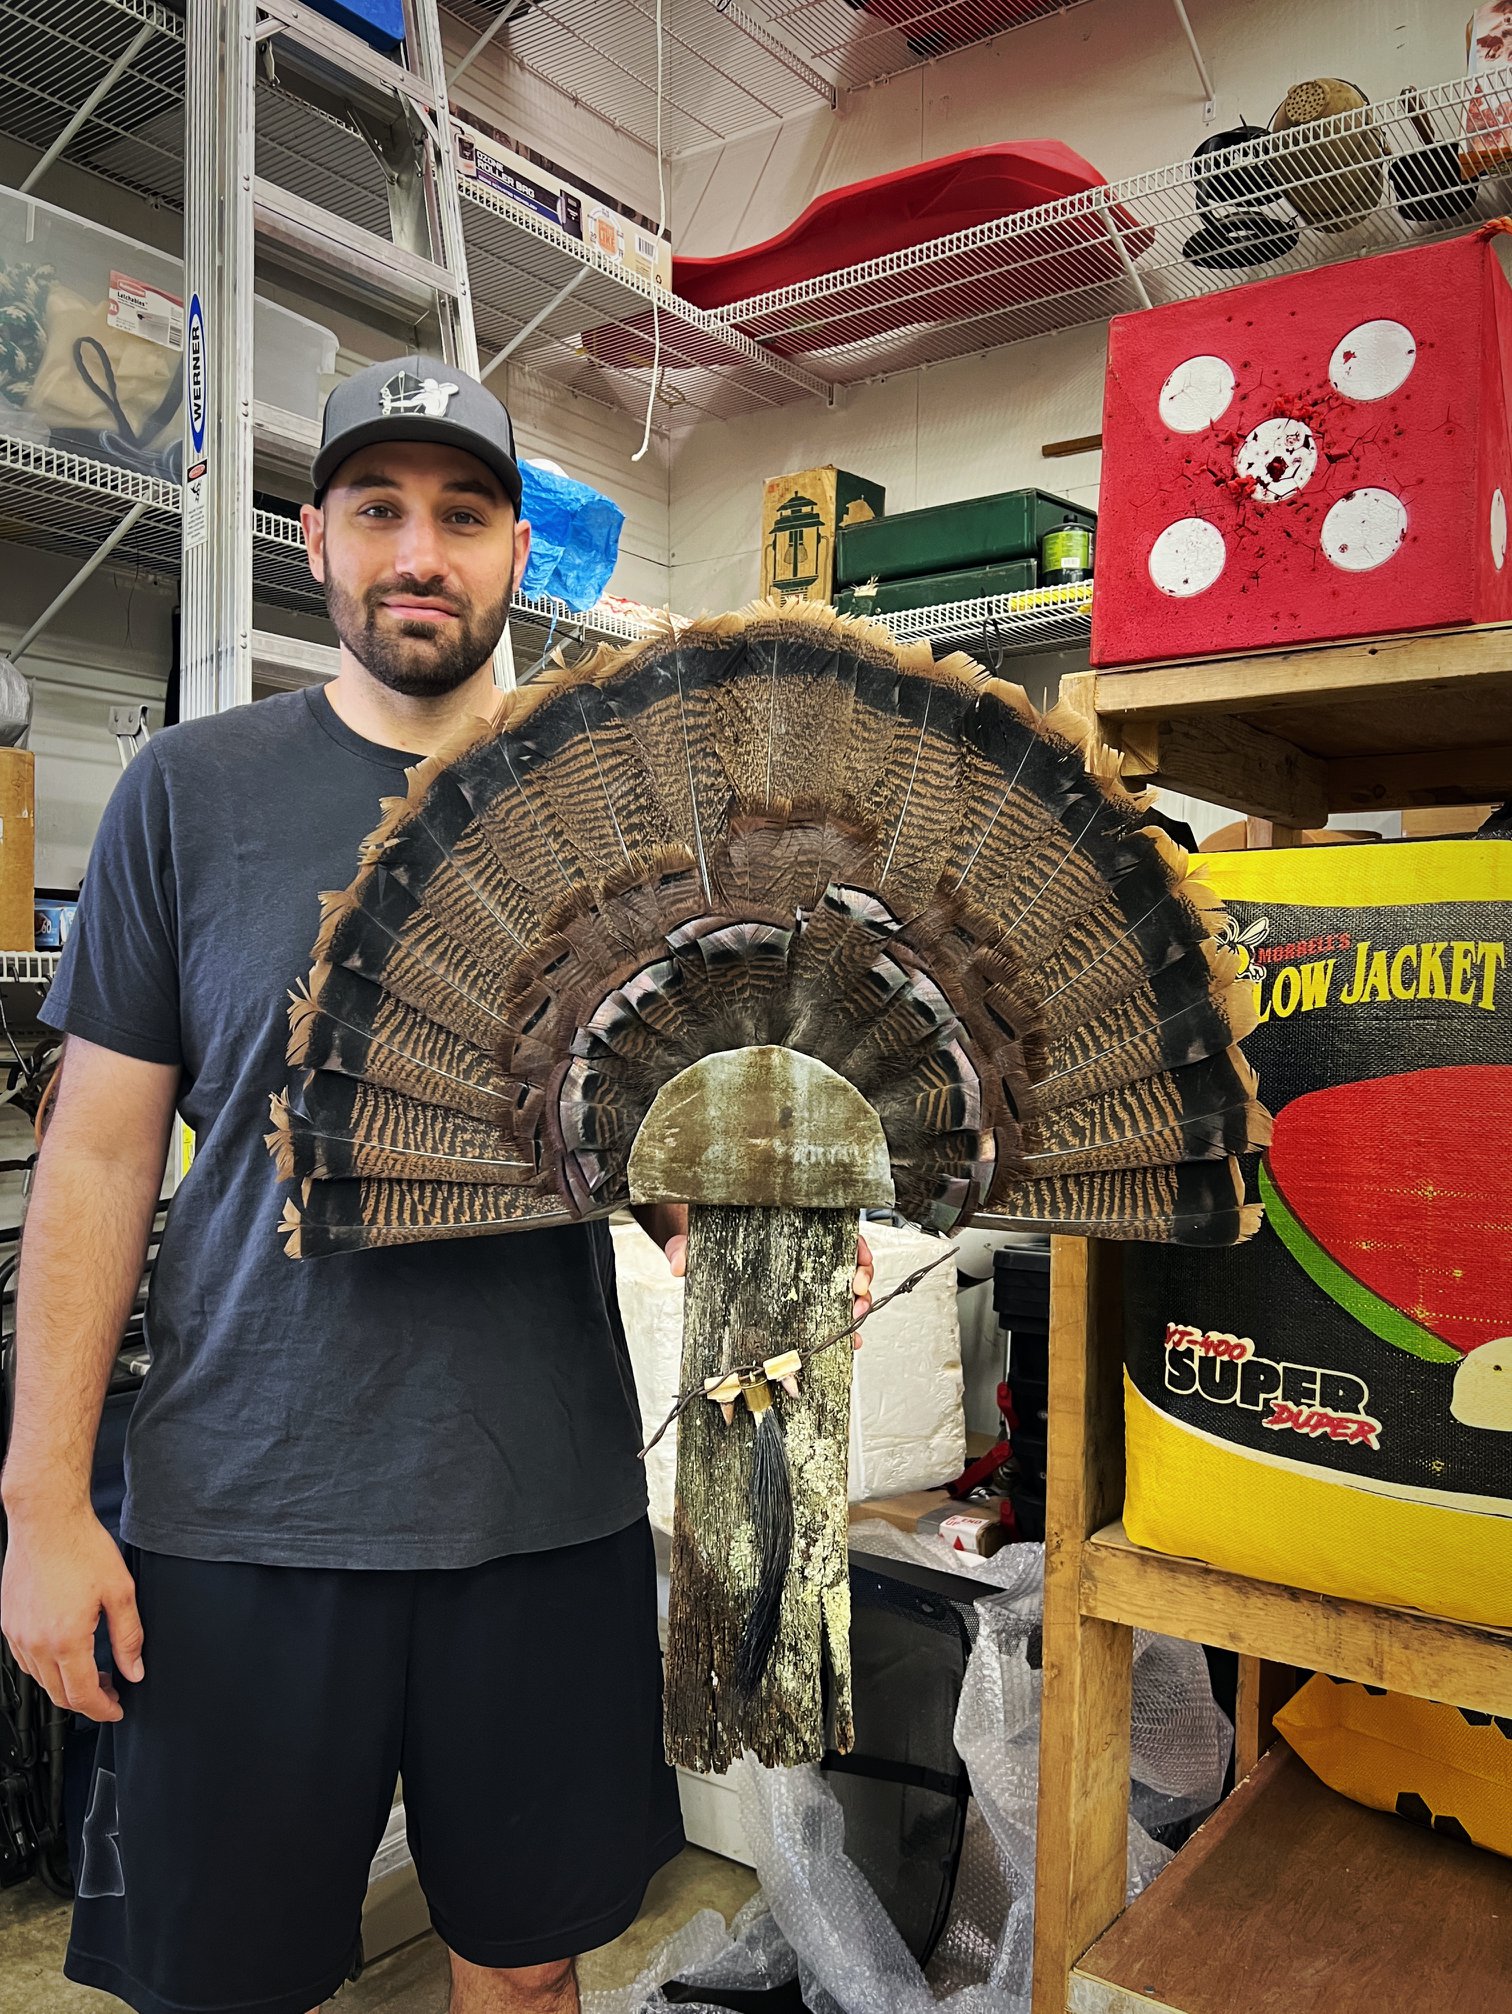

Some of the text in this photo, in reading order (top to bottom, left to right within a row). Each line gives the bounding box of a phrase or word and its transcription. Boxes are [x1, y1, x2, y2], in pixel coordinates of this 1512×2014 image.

[477, 150, 504, 172] OZONE
[477, 160, 515, 187] ROLLER
[515, 180, 535, 199] BAG
[192, 325, 202, 422] WERNER
[1258, 932, 1351, 964] MORRELL'S
[1340, 940, 1505, 1012] JACKET
[1164, 1347, 1369, 1416] SUPER
[1263, 1401, 1381, 1450] DUPER
